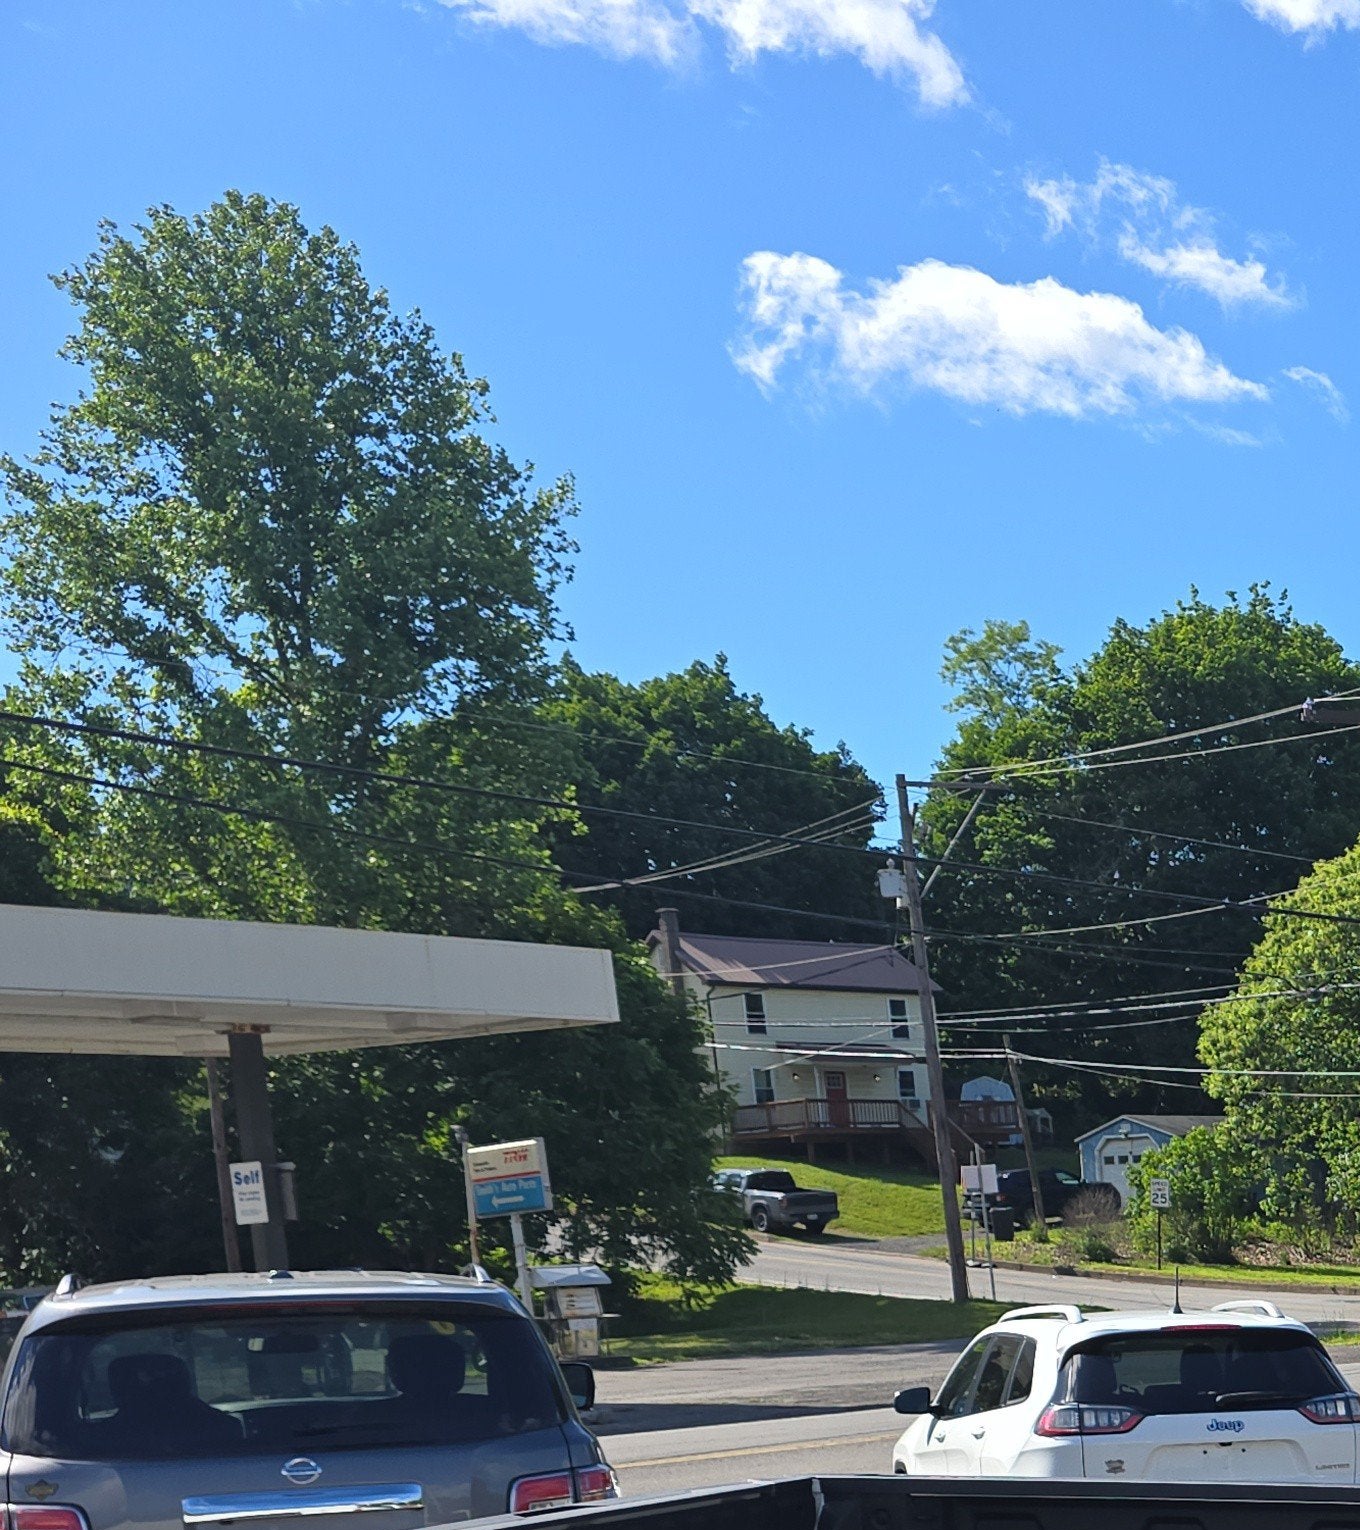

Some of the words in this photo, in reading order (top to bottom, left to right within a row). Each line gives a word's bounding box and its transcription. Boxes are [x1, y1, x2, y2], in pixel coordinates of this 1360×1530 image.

[233, 1170, 260, 1186] Self
[1152, 1193, 1168, 1204] 25
[1206, 1418, 1246, 1433] Jeep
